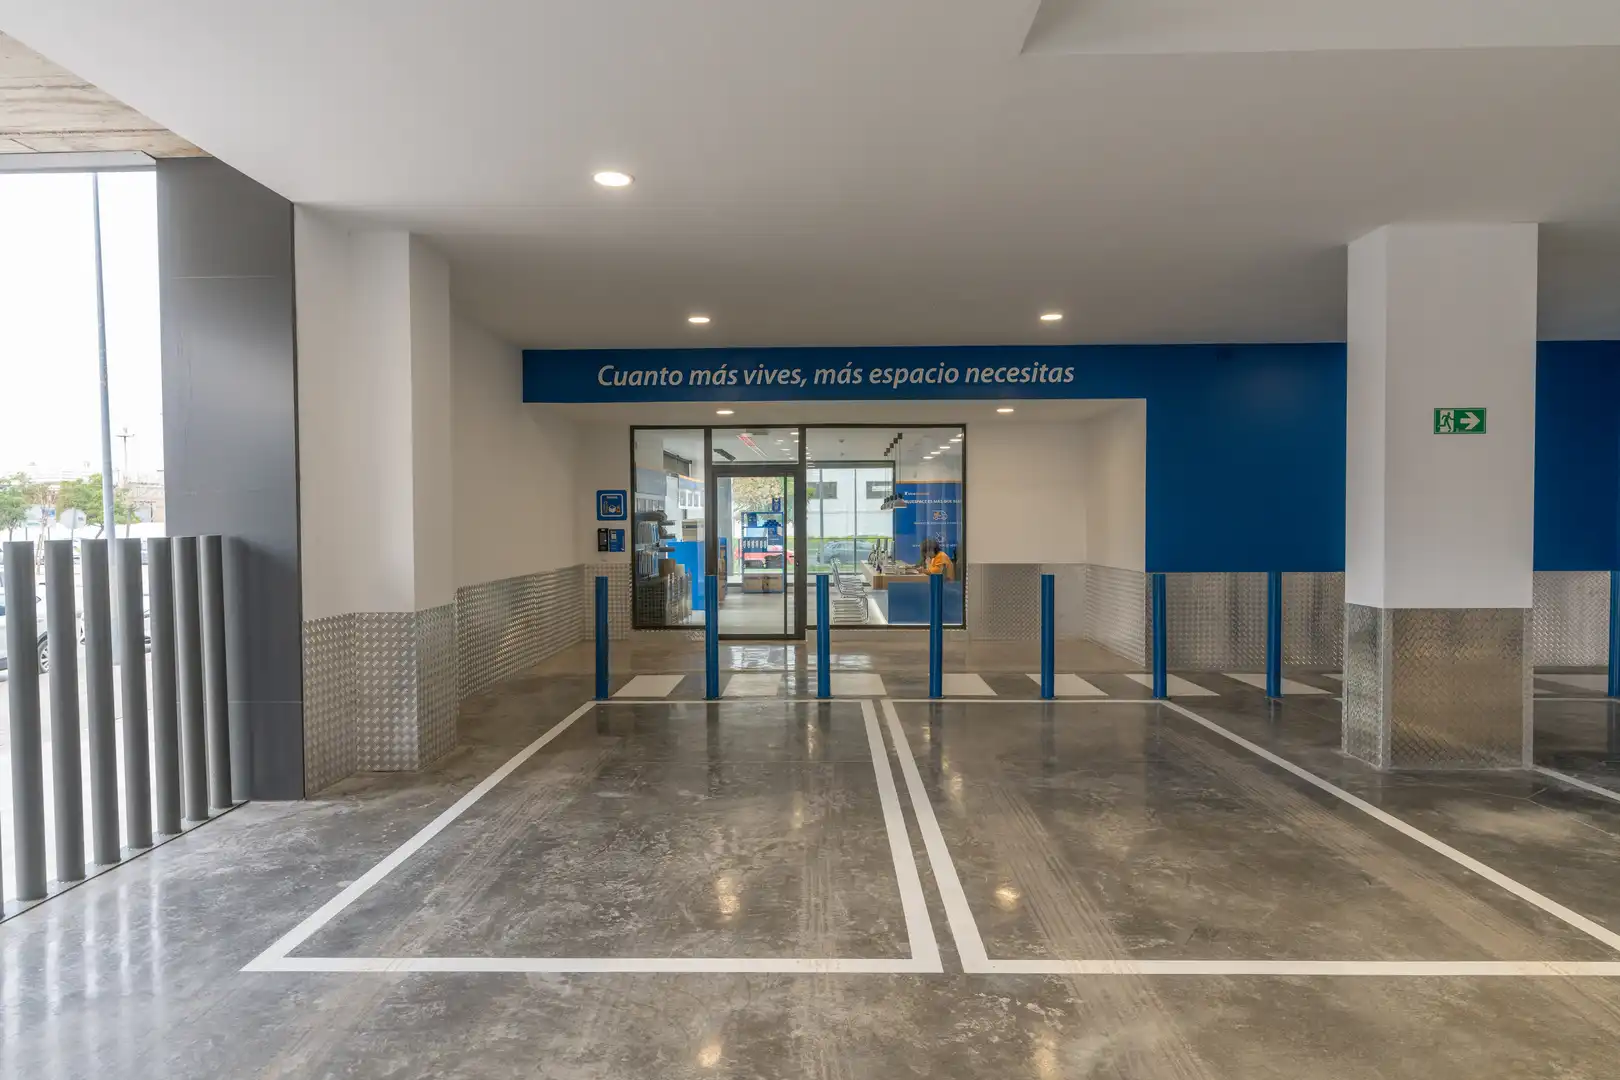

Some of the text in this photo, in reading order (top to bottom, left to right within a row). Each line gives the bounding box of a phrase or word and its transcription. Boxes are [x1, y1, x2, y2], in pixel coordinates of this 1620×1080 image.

[598, 362, 1075, 389] Cuanto más vives, más espacio necesitas
